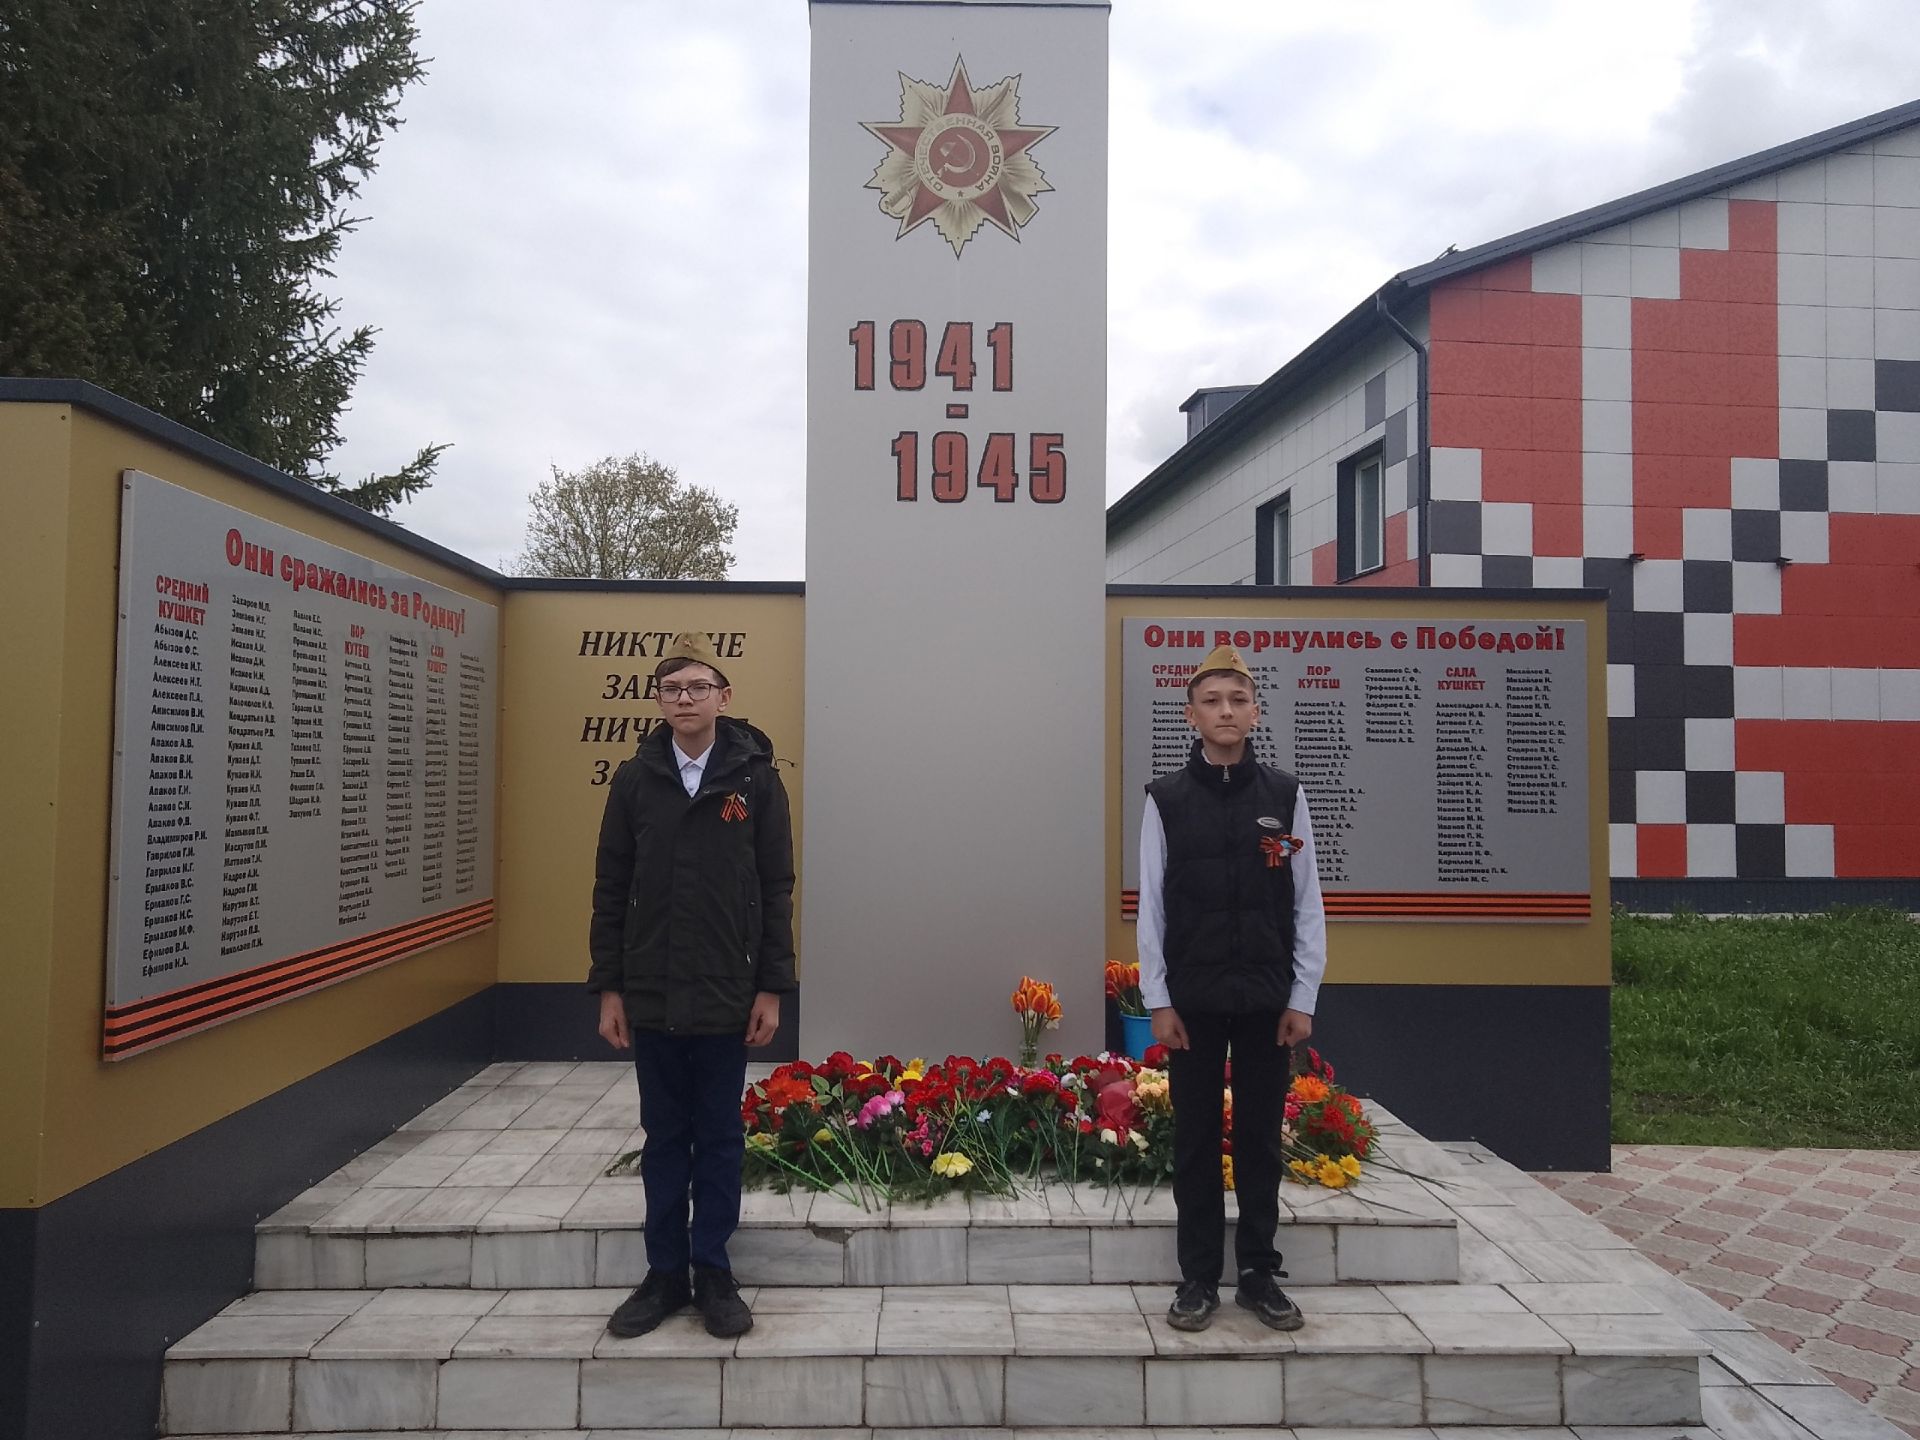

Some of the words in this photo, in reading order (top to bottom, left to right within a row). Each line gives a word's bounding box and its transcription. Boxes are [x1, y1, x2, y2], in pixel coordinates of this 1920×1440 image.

[849, 319, 1013, 391] 1941
[891, 431, 1066, 503] 1945
[156, 575, 209, 604] СРЕДНИЙ
[225, 528, 274, 577] Они
[280, 554, 387, 610] сражались
[390, 591, 409, 617] за
[413, 591, 466, 637] Родину!
[158, 600, 206, 626] КУШКЕТ
[154, 623, 184, 638] Абызов
[154, 639, 184, 653] Абызов
[578, 631, 682, 657] НИКТ
[1144, 625, 1205, 648] Они
[1214, 627, 1382, 653] вернулись
[1390, 630, 1409, 649] с
[1416, 625, 1566, 654] Победой!
[153, 655, 190, 670] Алексеев
[1152, 663, 1203, 678] СРЕДНИ
[1307, 665, 1332, 676] ПОР
[153, 671, 189, 686] Алексеев
[1155, 677, 1192, 688] КУШК
[1298, 678, 1341, 689] КУТЕШ
[1437, 680, 1486, 691] КУШКЕТ
[152, 688, 189, 702] Алексеев
